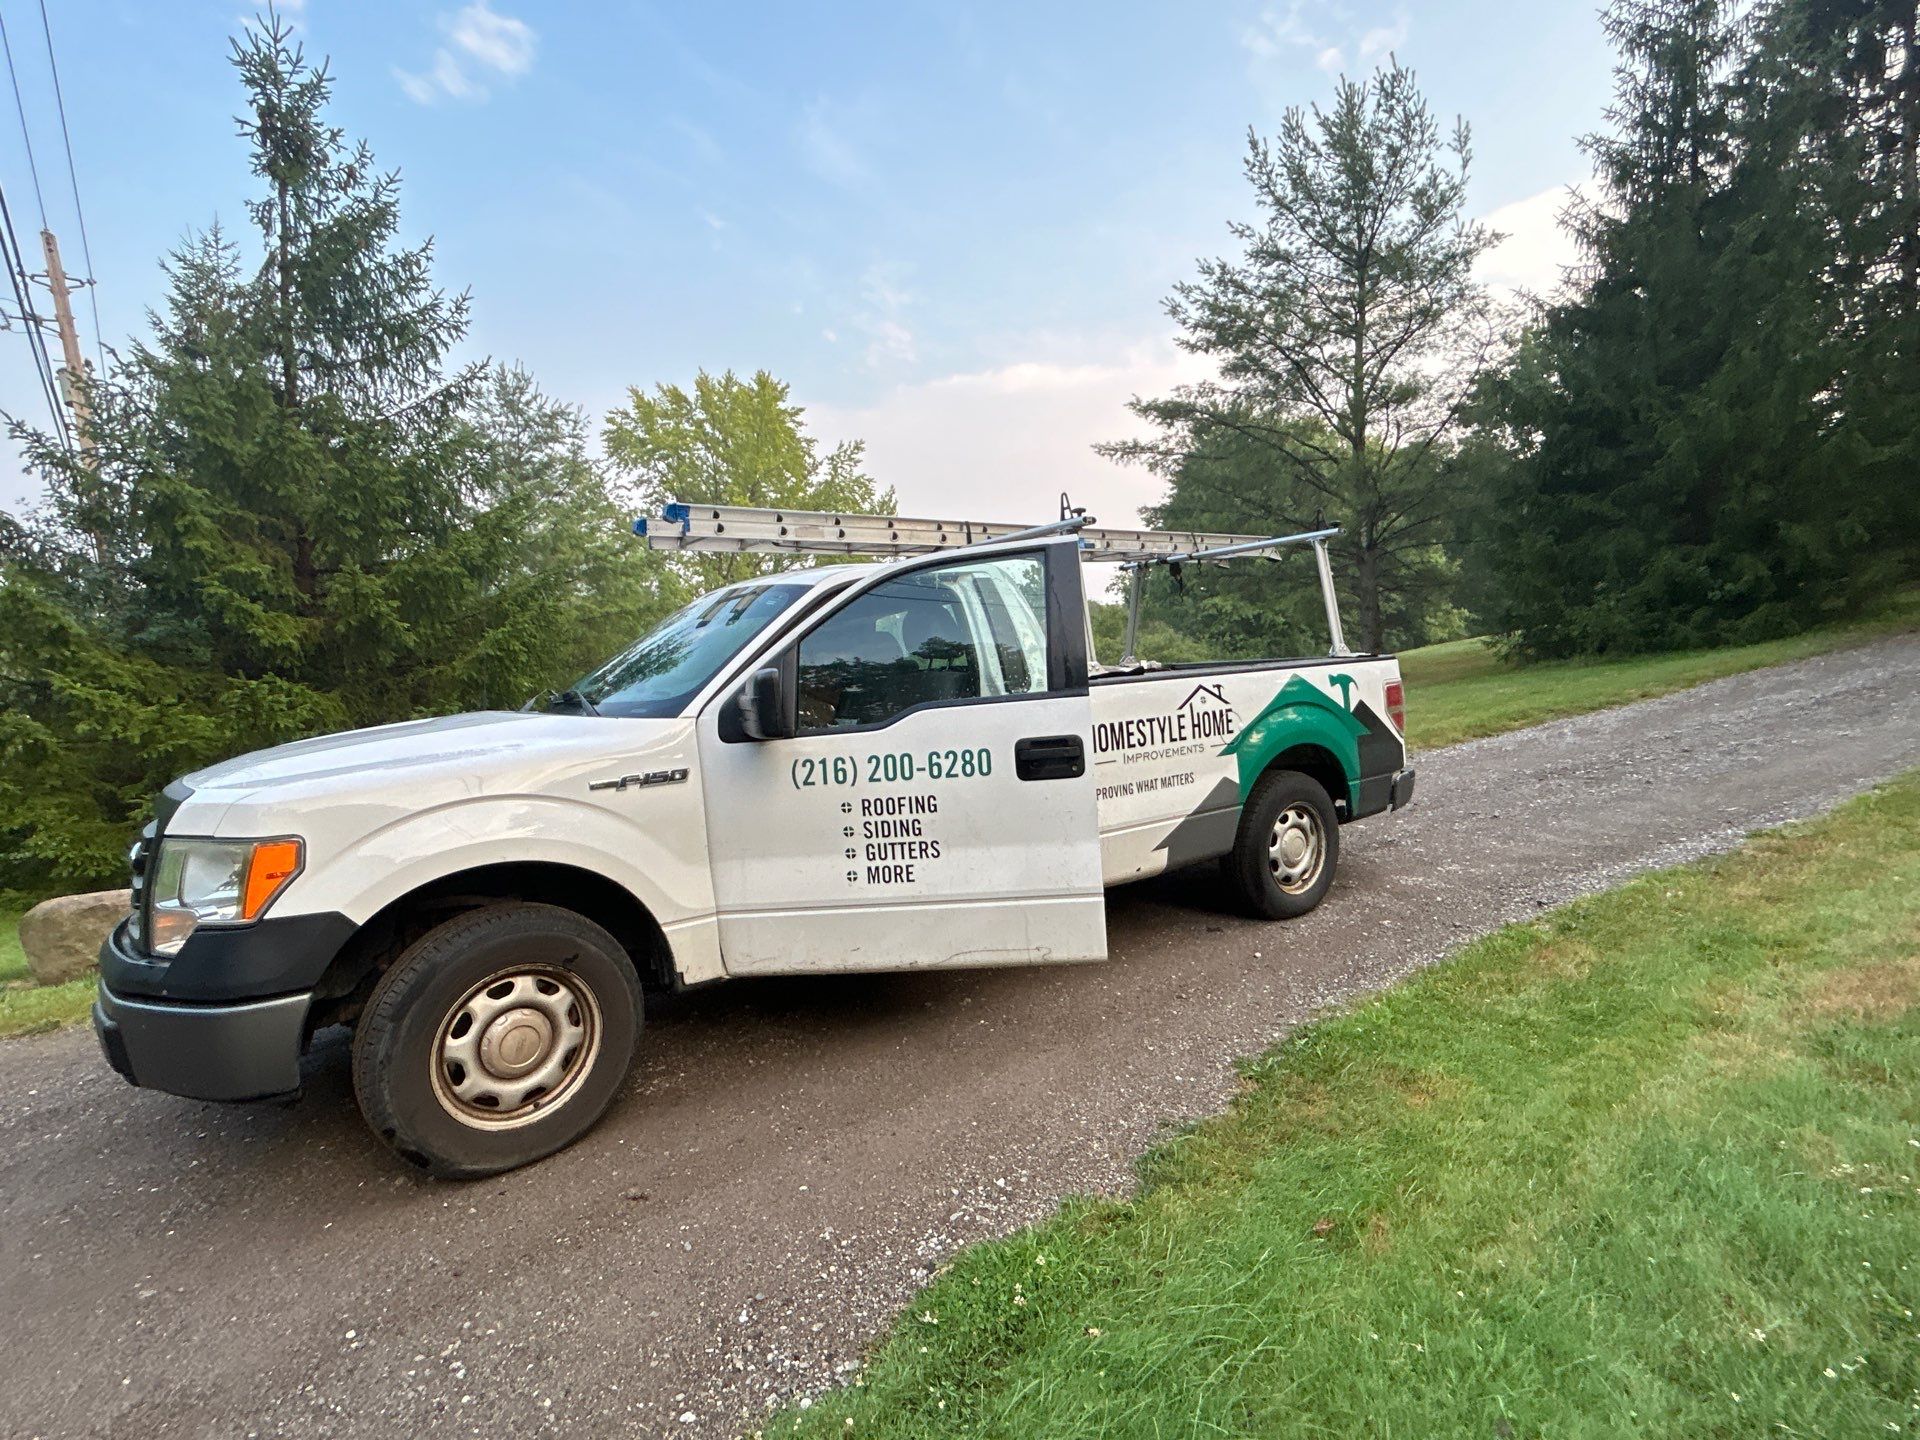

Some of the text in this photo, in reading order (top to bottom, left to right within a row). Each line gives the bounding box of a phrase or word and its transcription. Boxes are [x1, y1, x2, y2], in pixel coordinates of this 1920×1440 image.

[1189, 702, 1234, 739] HOME
[1123, 743, 1205, 765] IMPROVEMENTS
[791, 747, 992, 790] (216) 200-6280
[1136, 776, 1159, 793] WHAT
[1160, 772, 1195, 789] MATTERS
[861, 795, 939, 817] ROOFING
[863, 819, 923, 839] SIDING
[866, 840, 941, 862] GUTTERS
[866, 864, 916, 885] MORE
